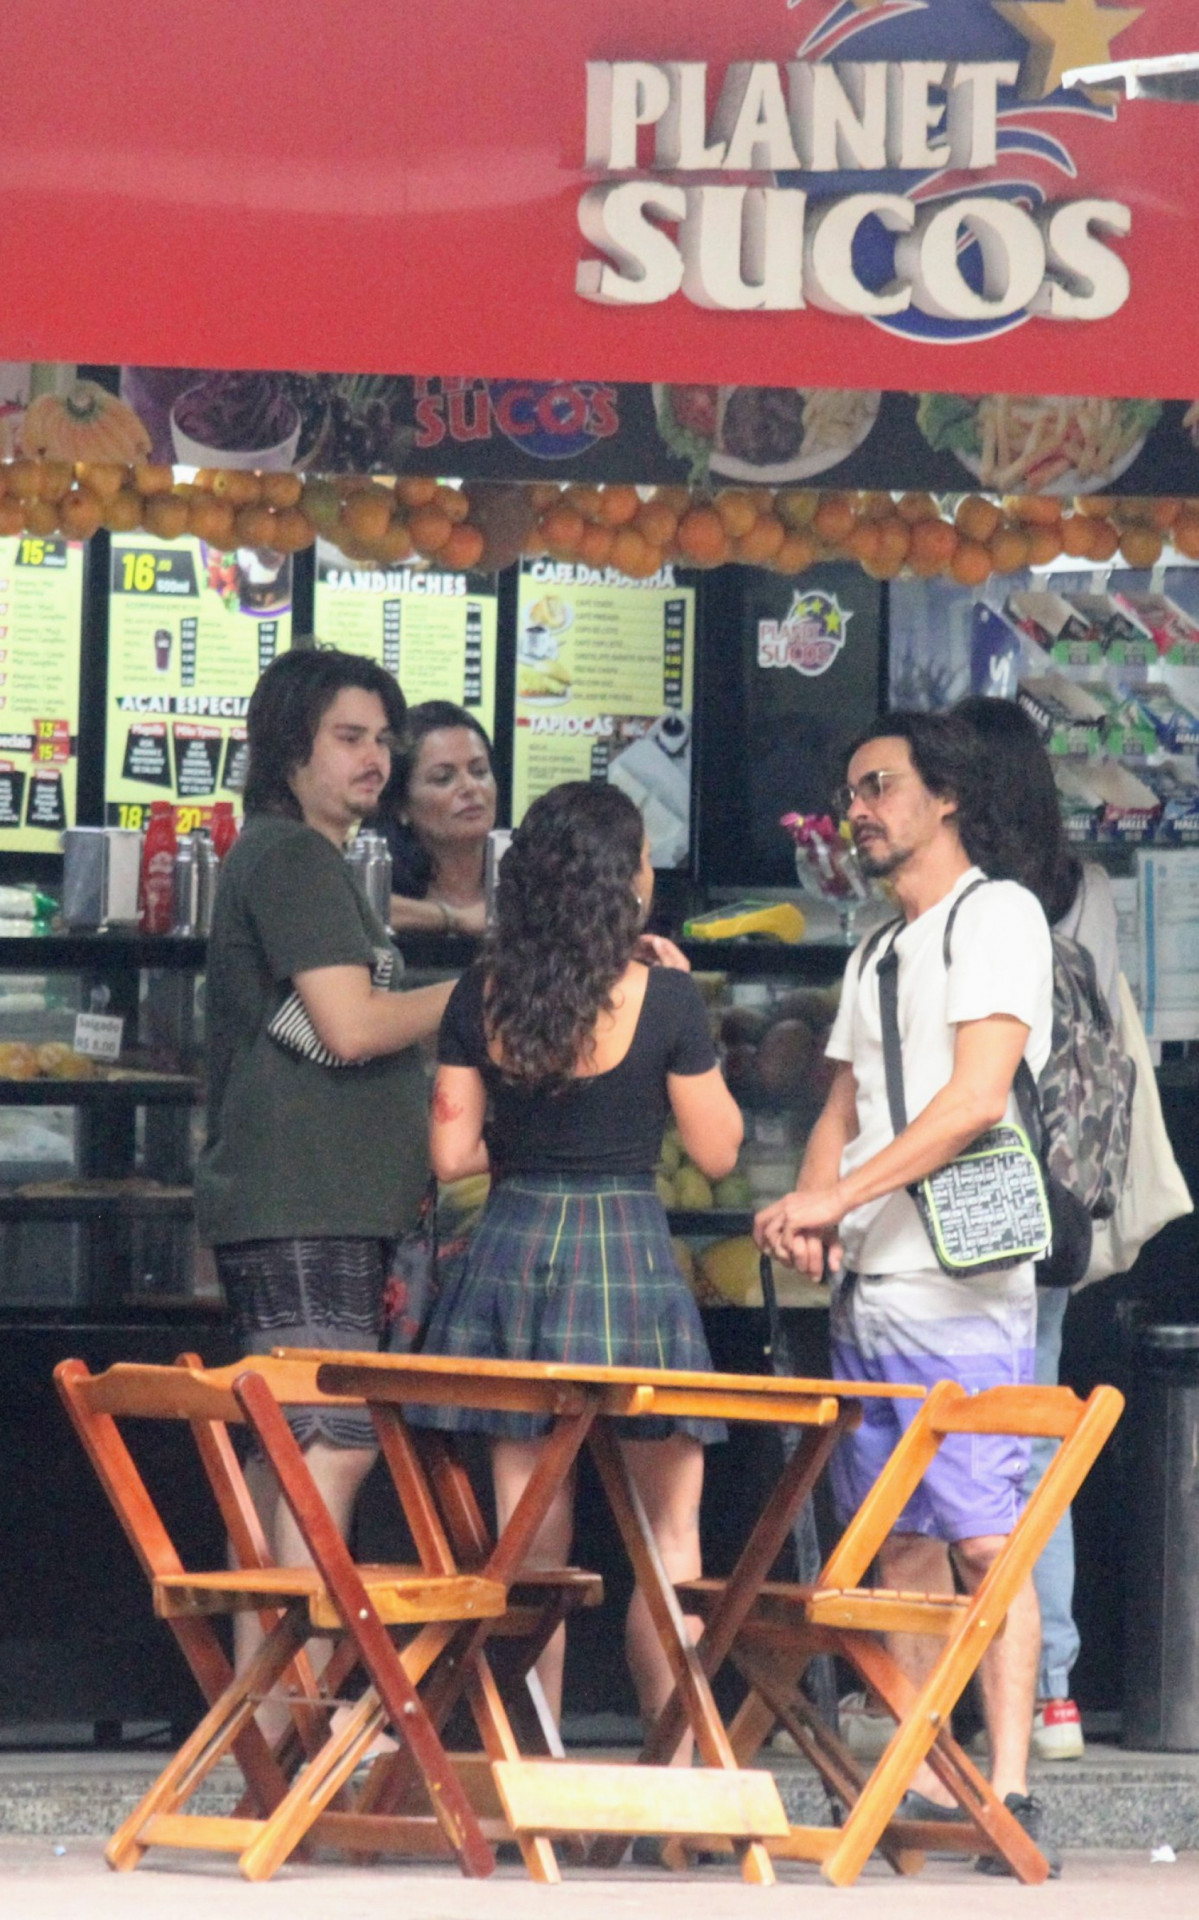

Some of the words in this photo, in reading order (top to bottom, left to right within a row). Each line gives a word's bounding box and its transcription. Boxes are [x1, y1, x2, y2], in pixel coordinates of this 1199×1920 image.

[588, 62, 1019, 171] PLANET
[578, 182, 1131, 321] SUCOS
[415, 386, 619, 448] SUCOS
[122, 553, 156, 592] 16
[326, 569, 467, 596] SANDUÍCHES
[121, 695, 170, 714] AÇAÍ
[531, 714, 613, 736] TAPIOCAS
